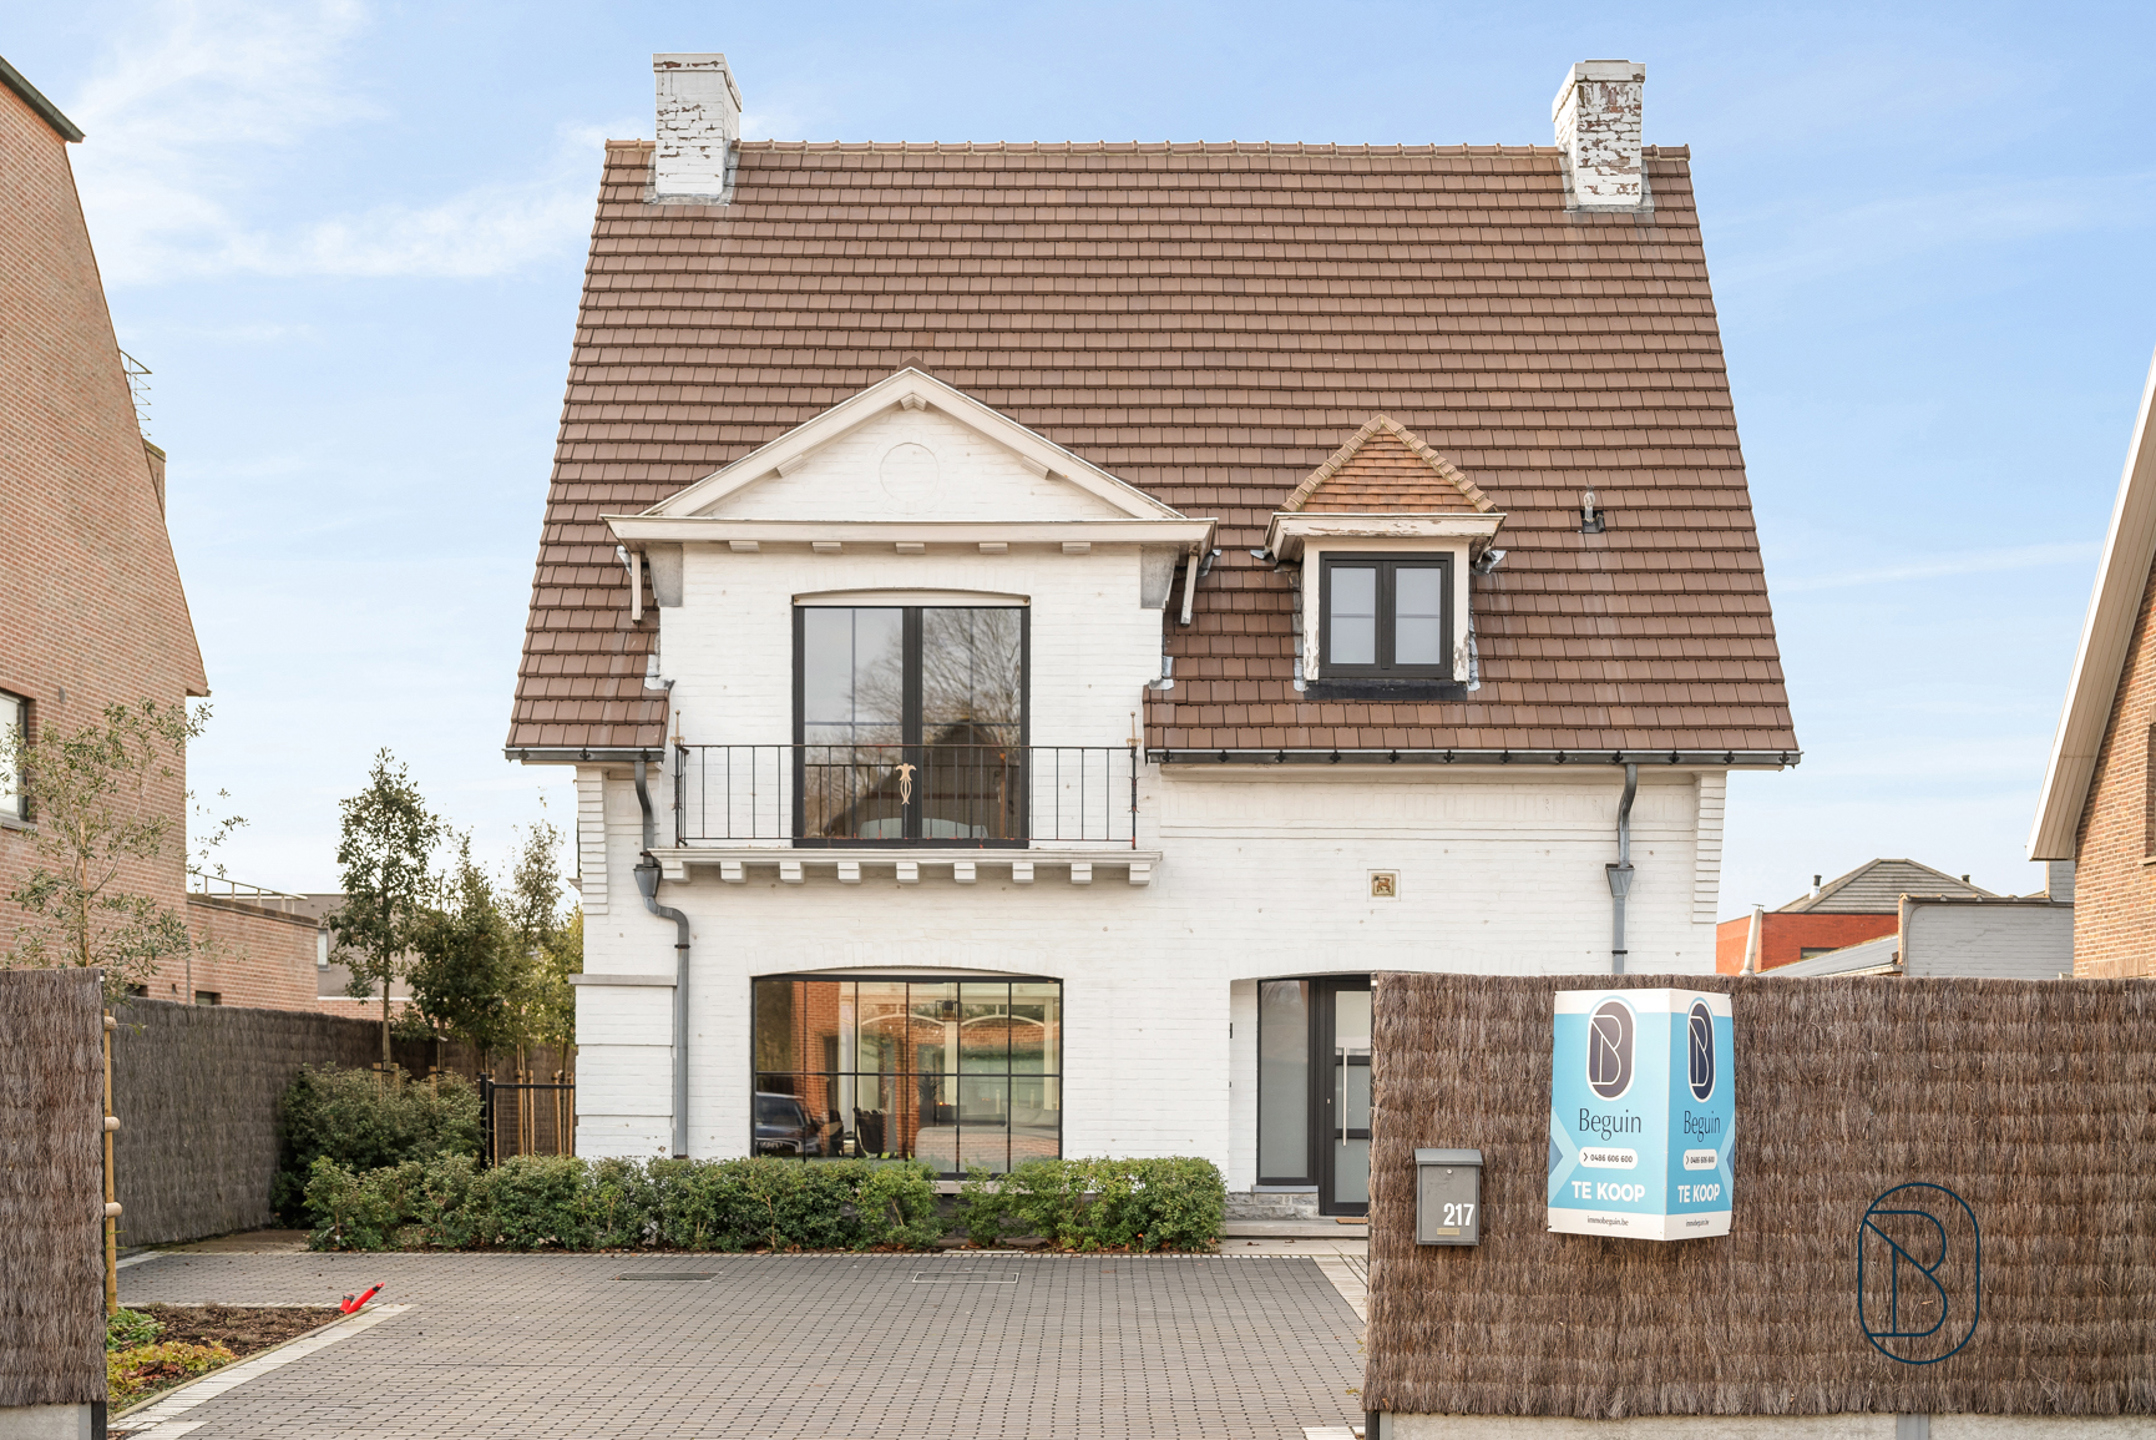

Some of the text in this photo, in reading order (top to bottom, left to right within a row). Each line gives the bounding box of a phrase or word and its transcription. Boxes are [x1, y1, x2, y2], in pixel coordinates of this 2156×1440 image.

[1578, 1107, 1642, 1141] Beguin
[1683, 1110, 1721, 1143] Beguin
[1571, 1181, 1646, 1202] TE KOOP
[1677, 1183, 1721, 1203] TE KOOP
[1442, 1202, 1475, 1227] 217
[1587, 1215, 1629, 1227] immobeguin.be
